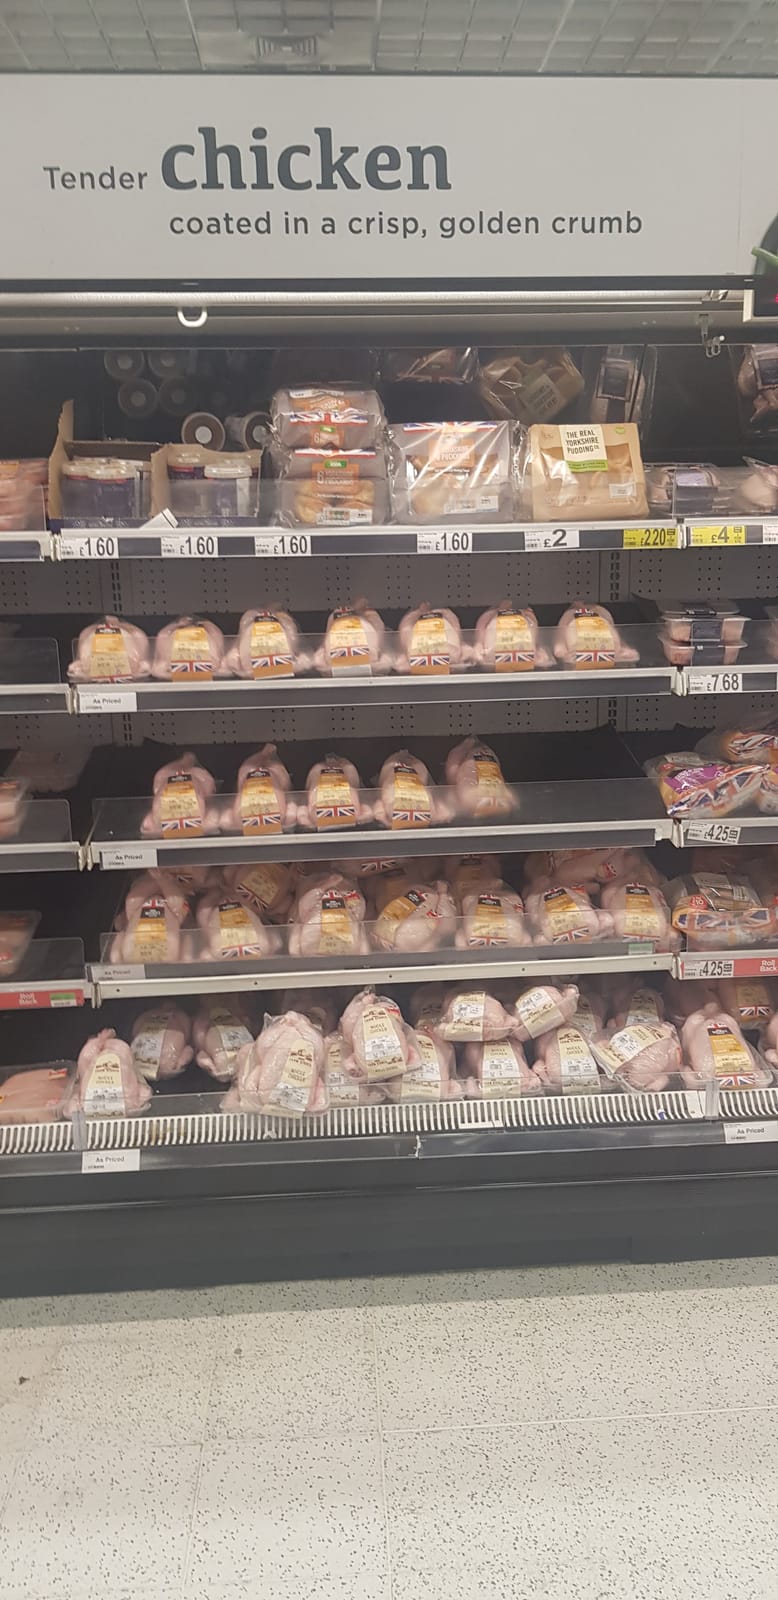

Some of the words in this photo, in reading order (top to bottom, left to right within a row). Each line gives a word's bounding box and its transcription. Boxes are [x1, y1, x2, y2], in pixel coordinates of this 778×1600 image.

[43, 165, 148, 190] Tender
[161, 126, 452, 191] chicken
[169, 210, 271, 235] coated
[284, 211, 309, 235] in
[321, 217, 336, 235] a
[348, 211, 427, 239] crisp,
[439, 210, 539, 239] golden
[551, 210, 642, 234] crumb
[566, 437, 599, 446] YORKSHIRE
[567, 445, 594, 454] PUDDING
[435, 532, 469, 551] £1.60
[544, 529, 568, 548] £2
[711, 526, 730, 543] £4
[80, 537, 115, 556] £1.60
[180, 536, 215, 555] £1.60
[274, 536, 308, 554] £1.60
[707, 673, 739, 691] £7.68
